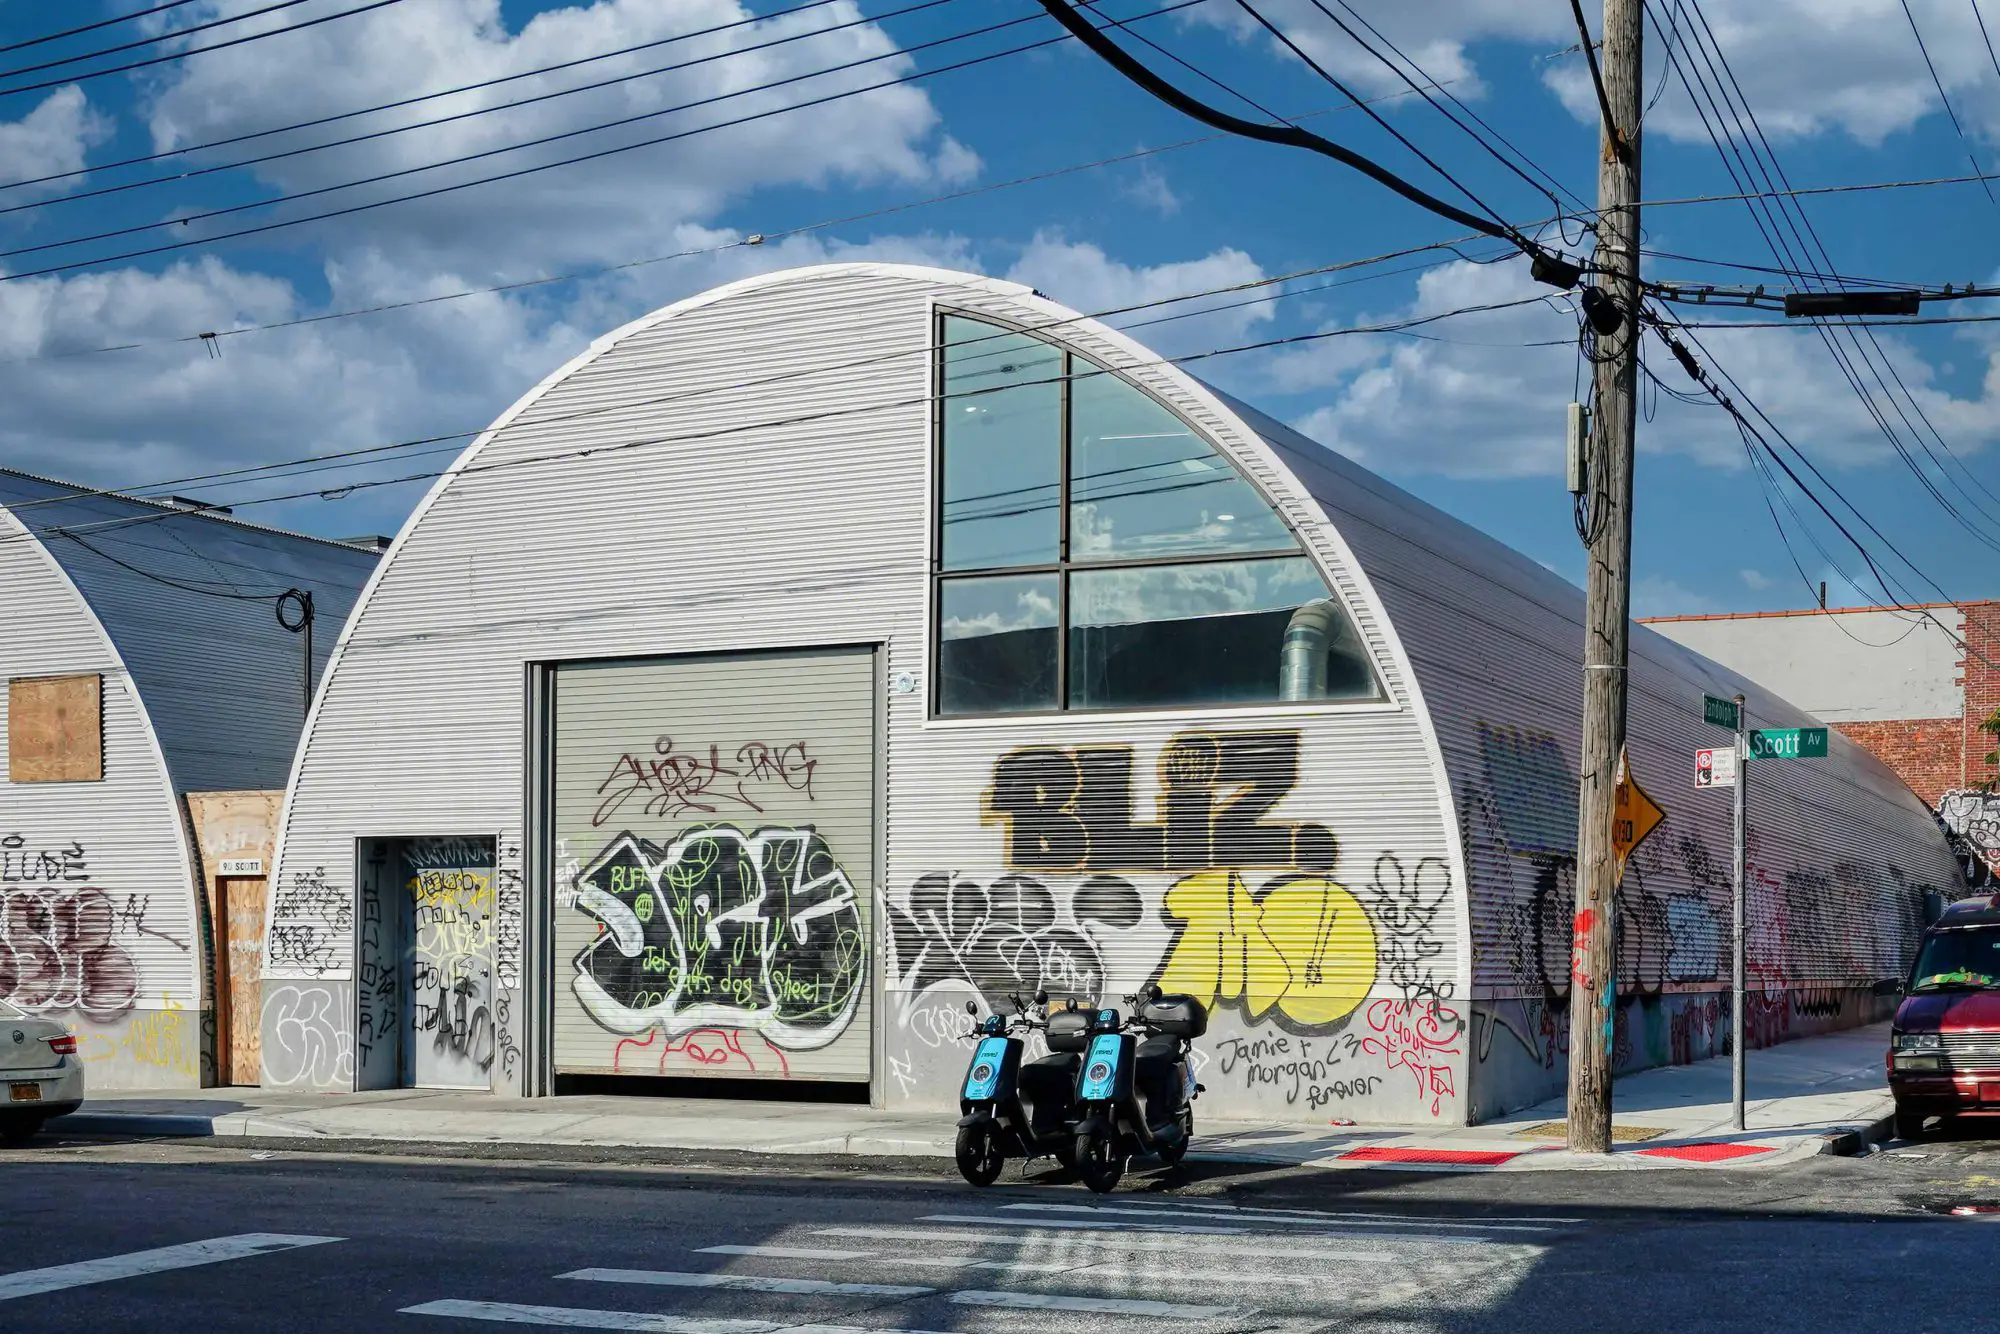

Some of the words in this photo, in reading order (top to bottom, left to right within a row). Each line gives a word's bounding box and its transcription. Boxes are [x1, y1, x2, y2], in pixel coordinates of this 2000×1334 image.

[1754, 732, 1800, 755] Scott
[1807, 732, 1821, 745] Av
[235, 862, 259, 871] SCOTT
[1216, 1030, 1290, 1074] Jamie
